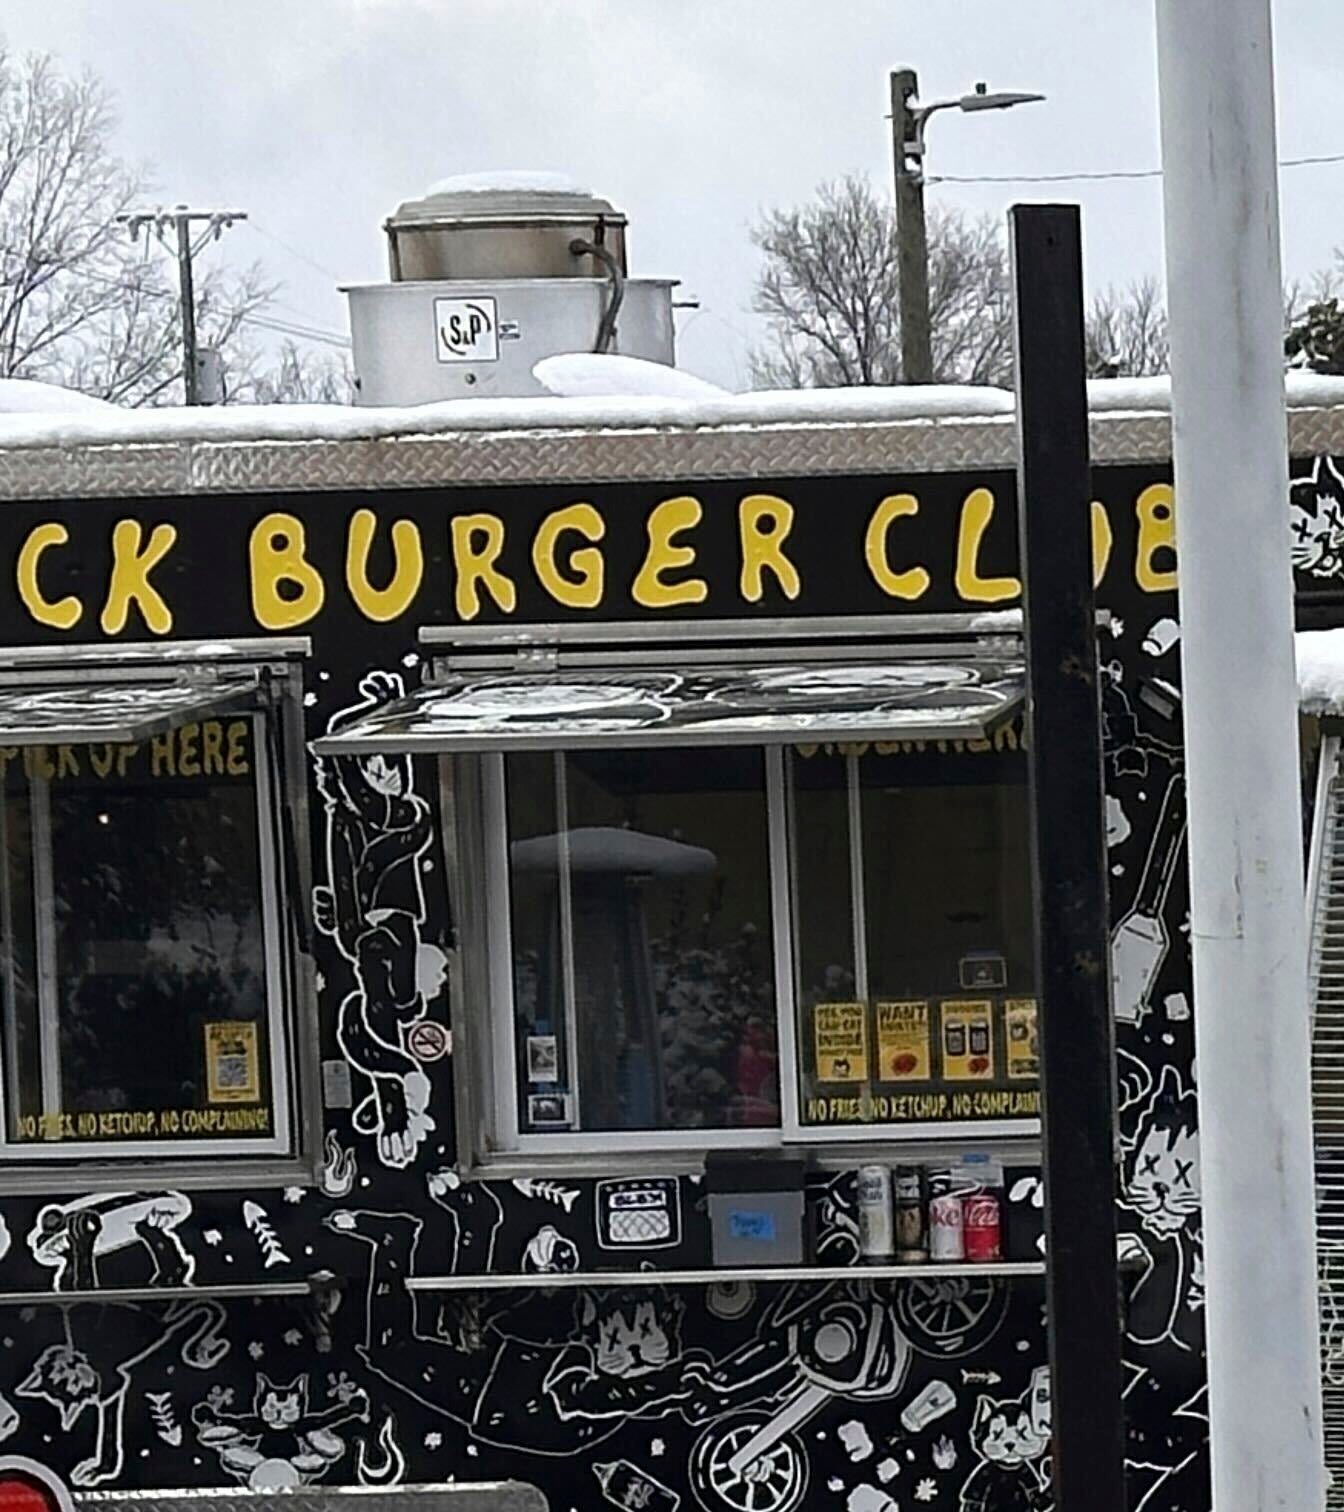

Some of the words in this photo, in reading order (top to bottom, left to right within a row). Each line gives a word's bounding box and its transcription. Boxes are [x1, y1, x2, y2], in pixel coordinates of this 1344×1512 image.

[17, 519, 177, 635] CK
[249, 495, 801, 630] BURGER
[865, 483, 1179, 604] CLB
[151, 720, 249, 777] HERE
[953, 1093, 972, 1116] NO
